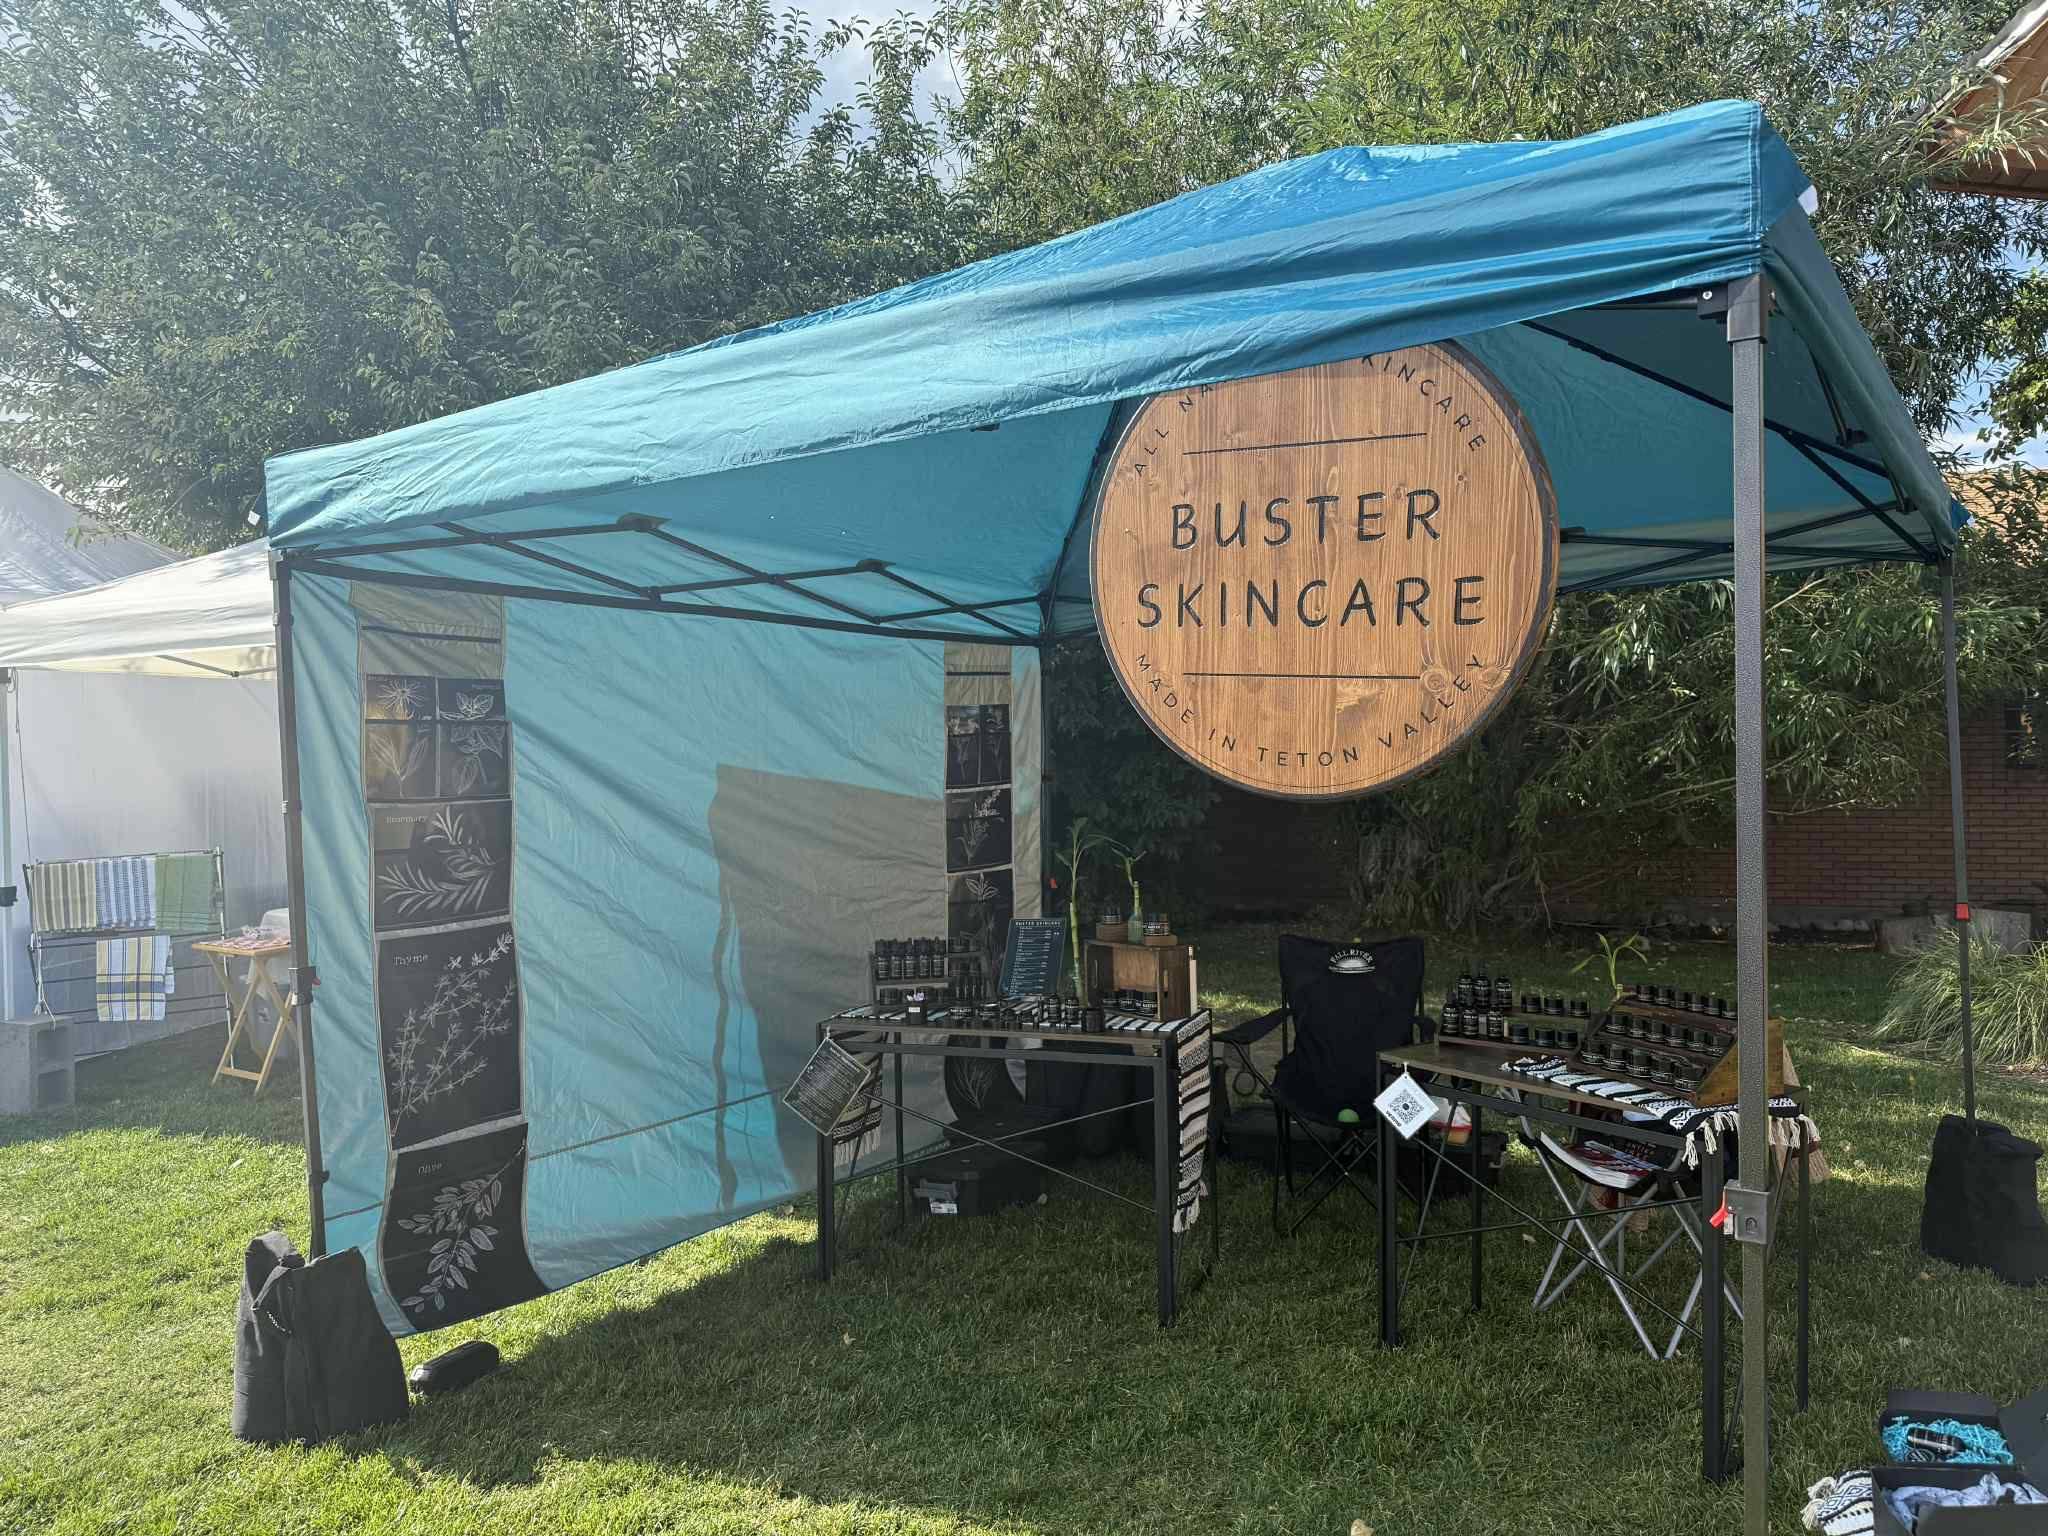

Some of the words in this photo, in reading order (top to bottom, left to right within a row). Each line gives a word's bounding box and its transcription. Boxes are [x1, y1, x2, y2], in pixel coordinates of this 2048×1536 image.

[1134, 428, 1170, 477] ALL
[1361, 353, 1487, 451] KINCARE
[1171, 488, 1442, 550] BUSTER
[1136, 575, 1487, 629] SKINCARE
[1135, 653, 1193, 725] MADE
[1208, 727, 1237, 753] IN
[1256, 746, 1360, 768] TETON
[1377, 653, 1483, 750] VALLEY
